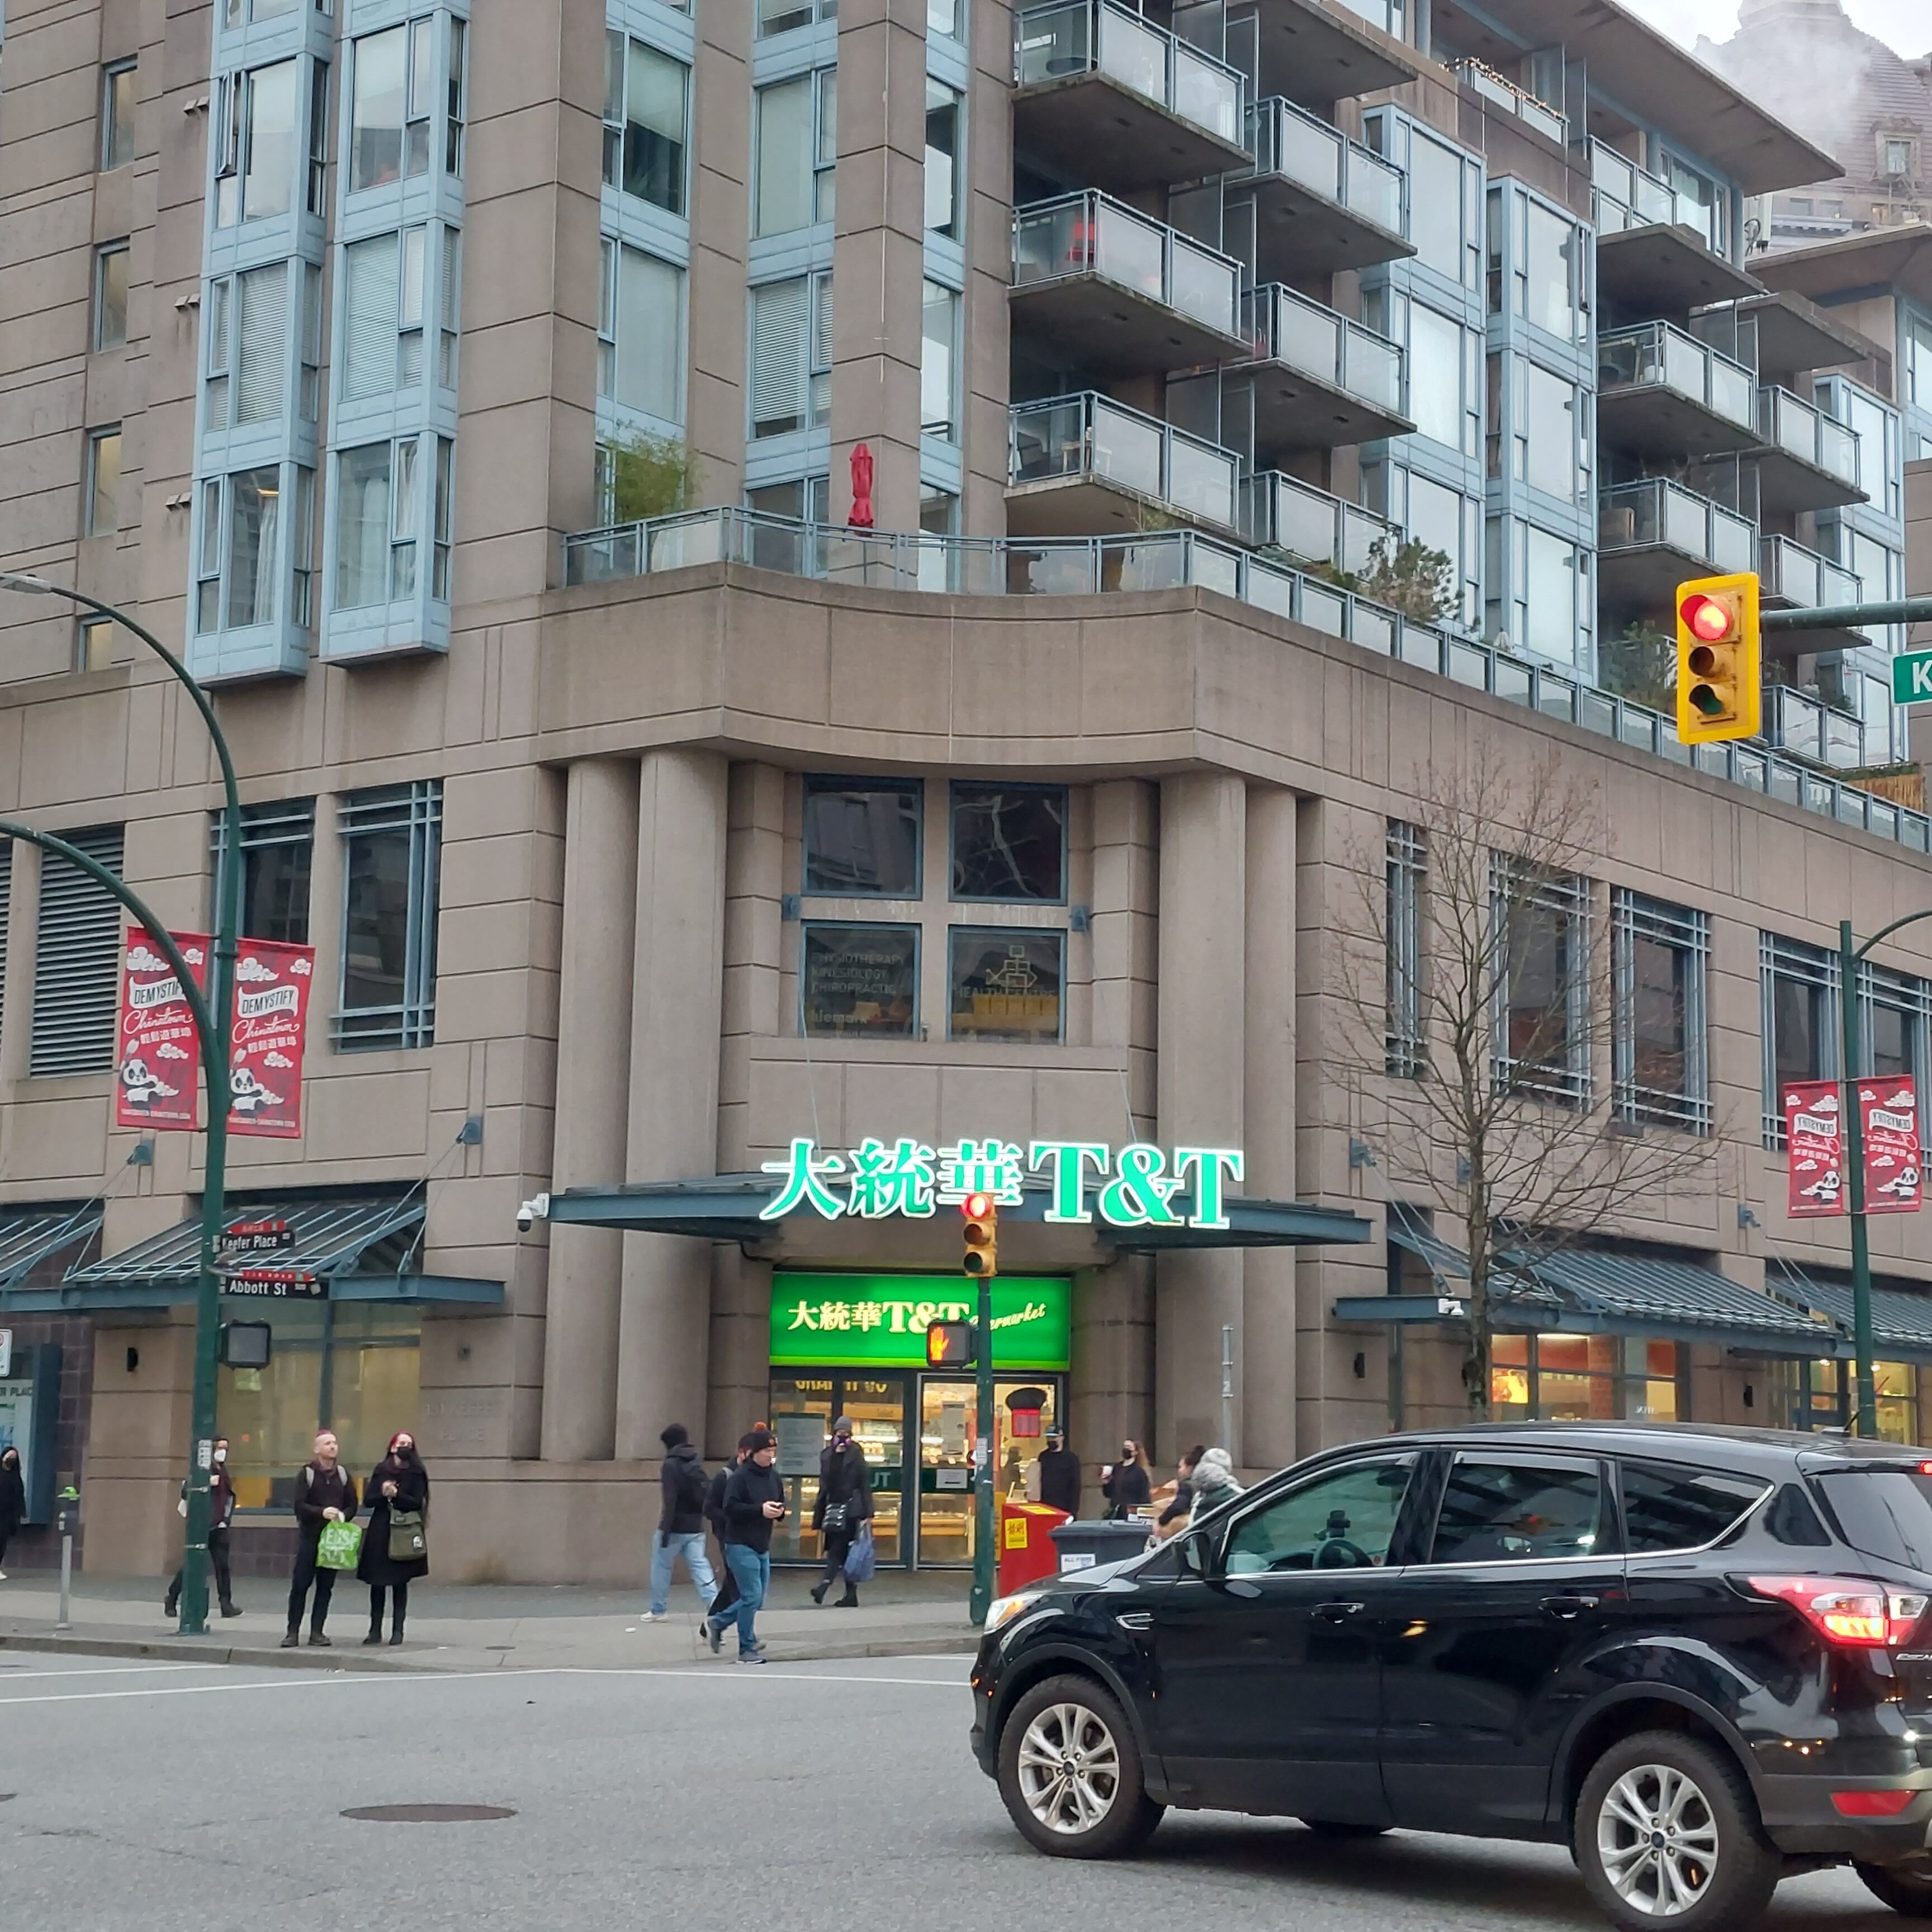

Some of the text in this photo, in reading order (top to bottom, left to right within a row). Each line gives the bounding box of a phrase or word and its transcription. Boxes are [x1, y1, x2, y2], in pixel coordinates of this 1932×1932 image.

[242, 989, 294, 1014] DEMYSTIFY
[759, 1137, 1244, 1230] 大統華 T&T
[253, 1234, 278, 1248] Place
[229, 1278, 287, 1296] Abbott St
[788, 1299, 882, 1333] 大統華
[882, 1301, 970, 1334] T&T
[11, 1386, 34, 1397] PLAC
